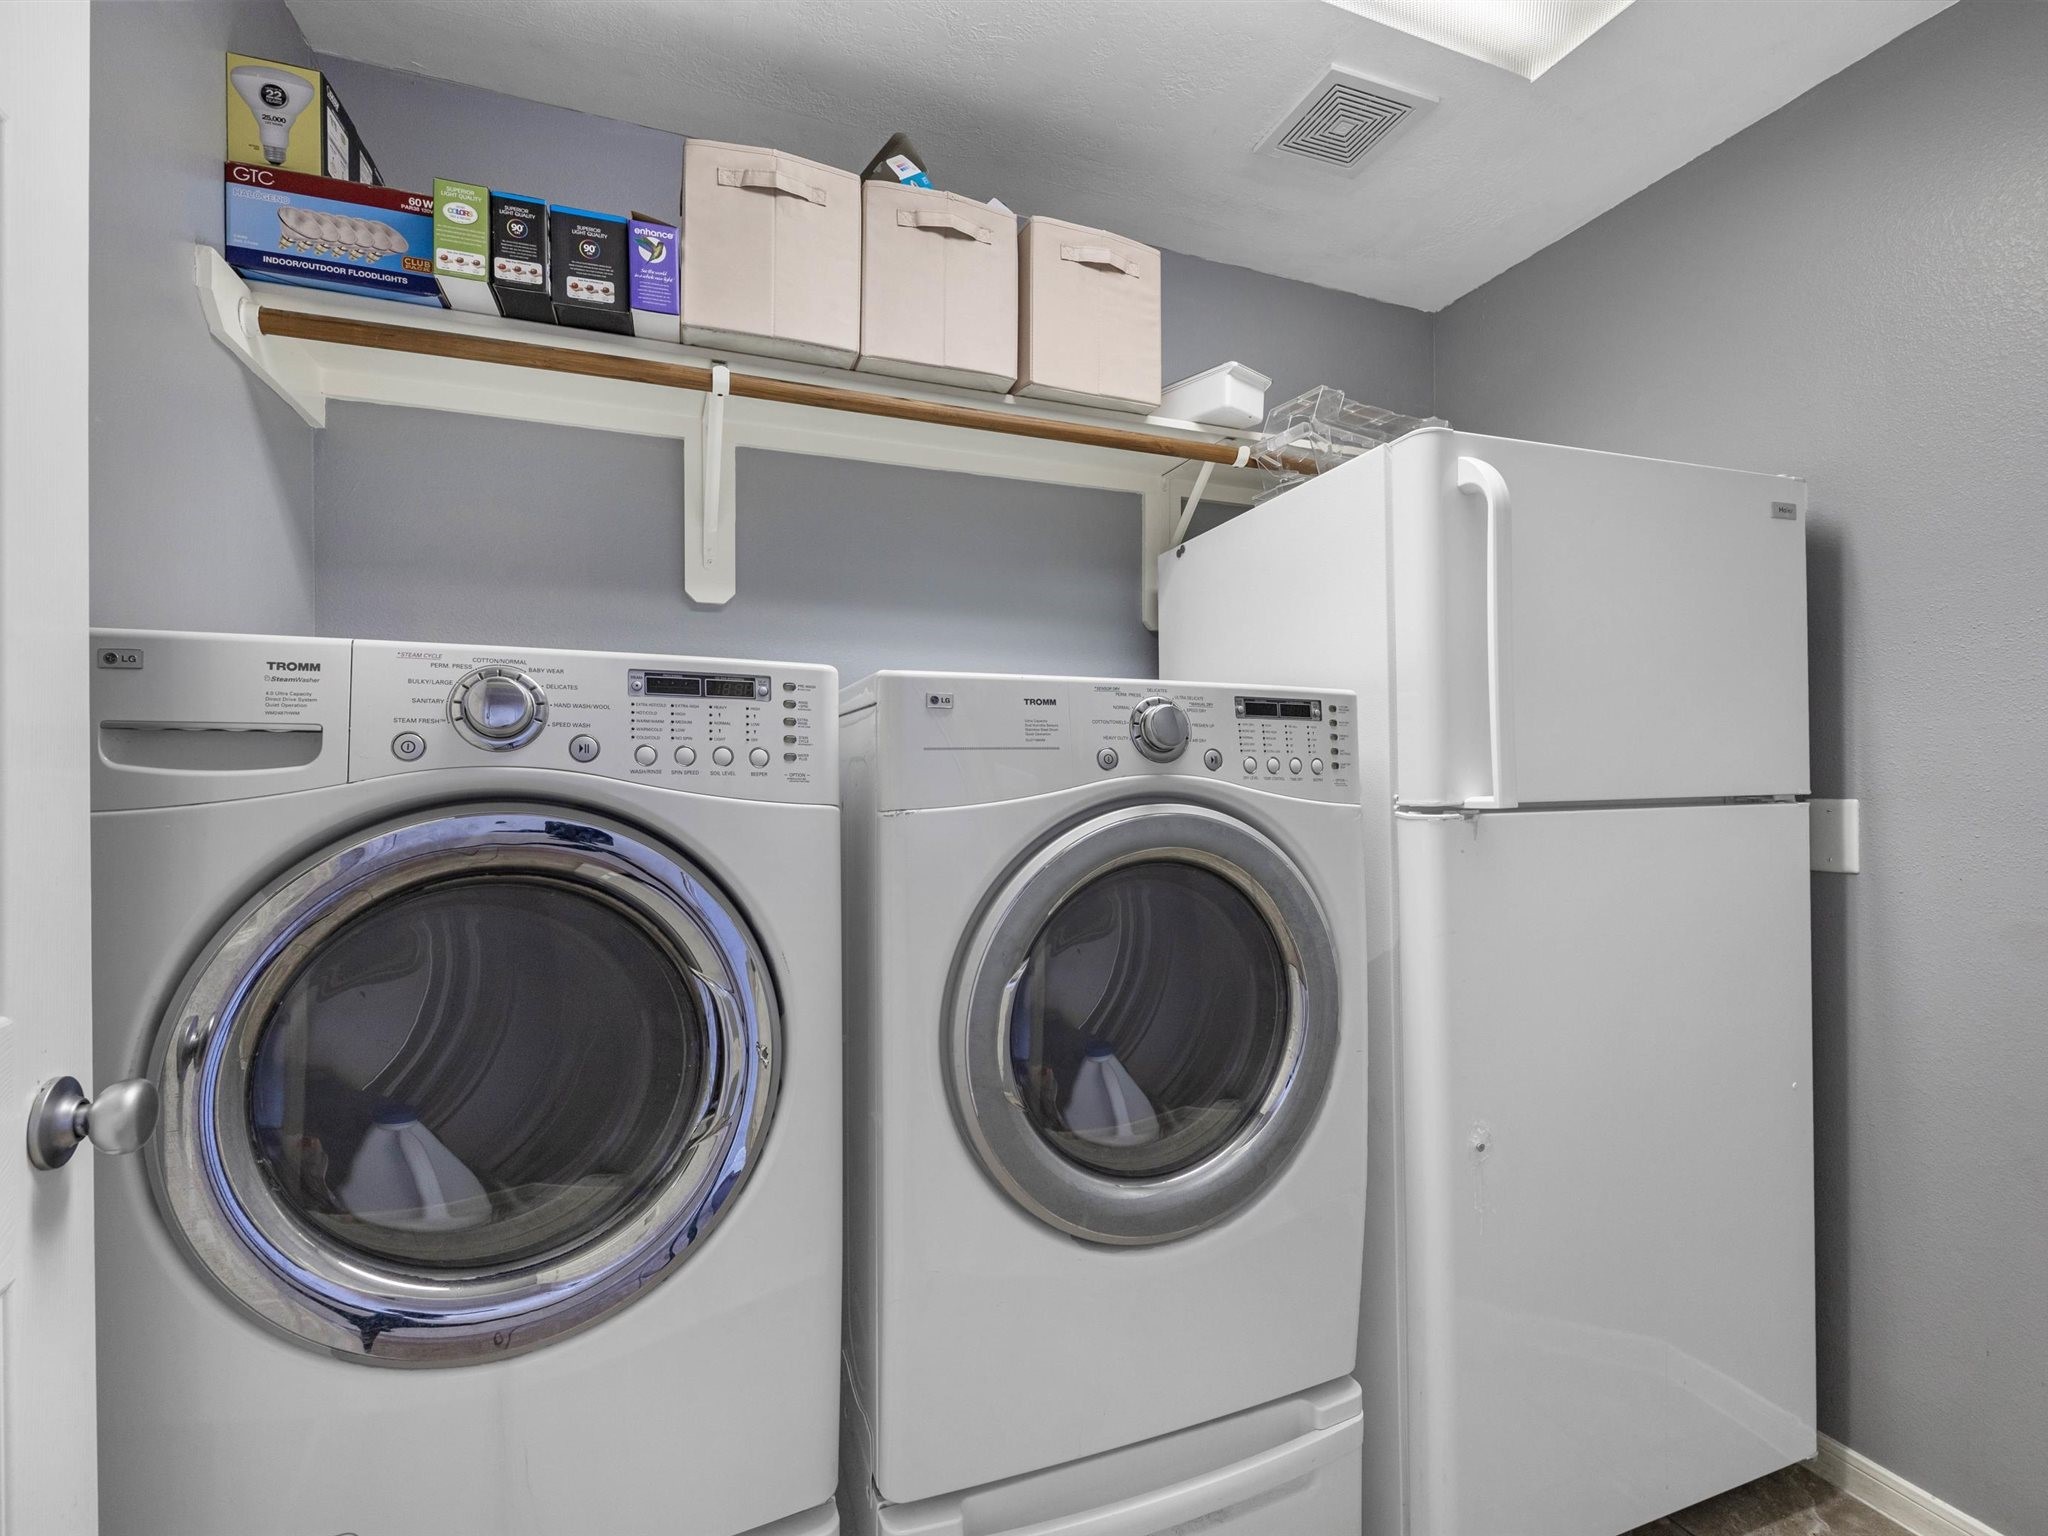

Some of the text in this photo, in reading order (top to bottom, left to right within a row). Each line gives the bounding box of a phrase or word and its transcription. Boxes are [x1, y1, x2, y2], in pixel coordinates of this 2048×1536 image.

[265, 89, 282, 99] 22
[262, 113, 287, 124] 25,000
[233, 166, 275, 186] GTC
[446, 186, 475, 195] SUPERIOR
[440, 190, 482, 202] LIGHT QUALITY
[504, 205, 529, 214] SUPERIOR
[514, 211, 536, 220] QUALITY
[576, 225, 602, 234] SUPERIOR
[634, 227, 674, 240] enhance
[586, 231, 608, 240] QUALITY
[404, 256, 431, 268] CLUB
[262, 255, 408, 285] INDOOR/OUTDOOR FLOODLIGHTS
[405, 264, 431, 273] PACK
[472, 657, 527, 665] COTTON/NORMAL
[266, 661, 320, 672] TROMM
